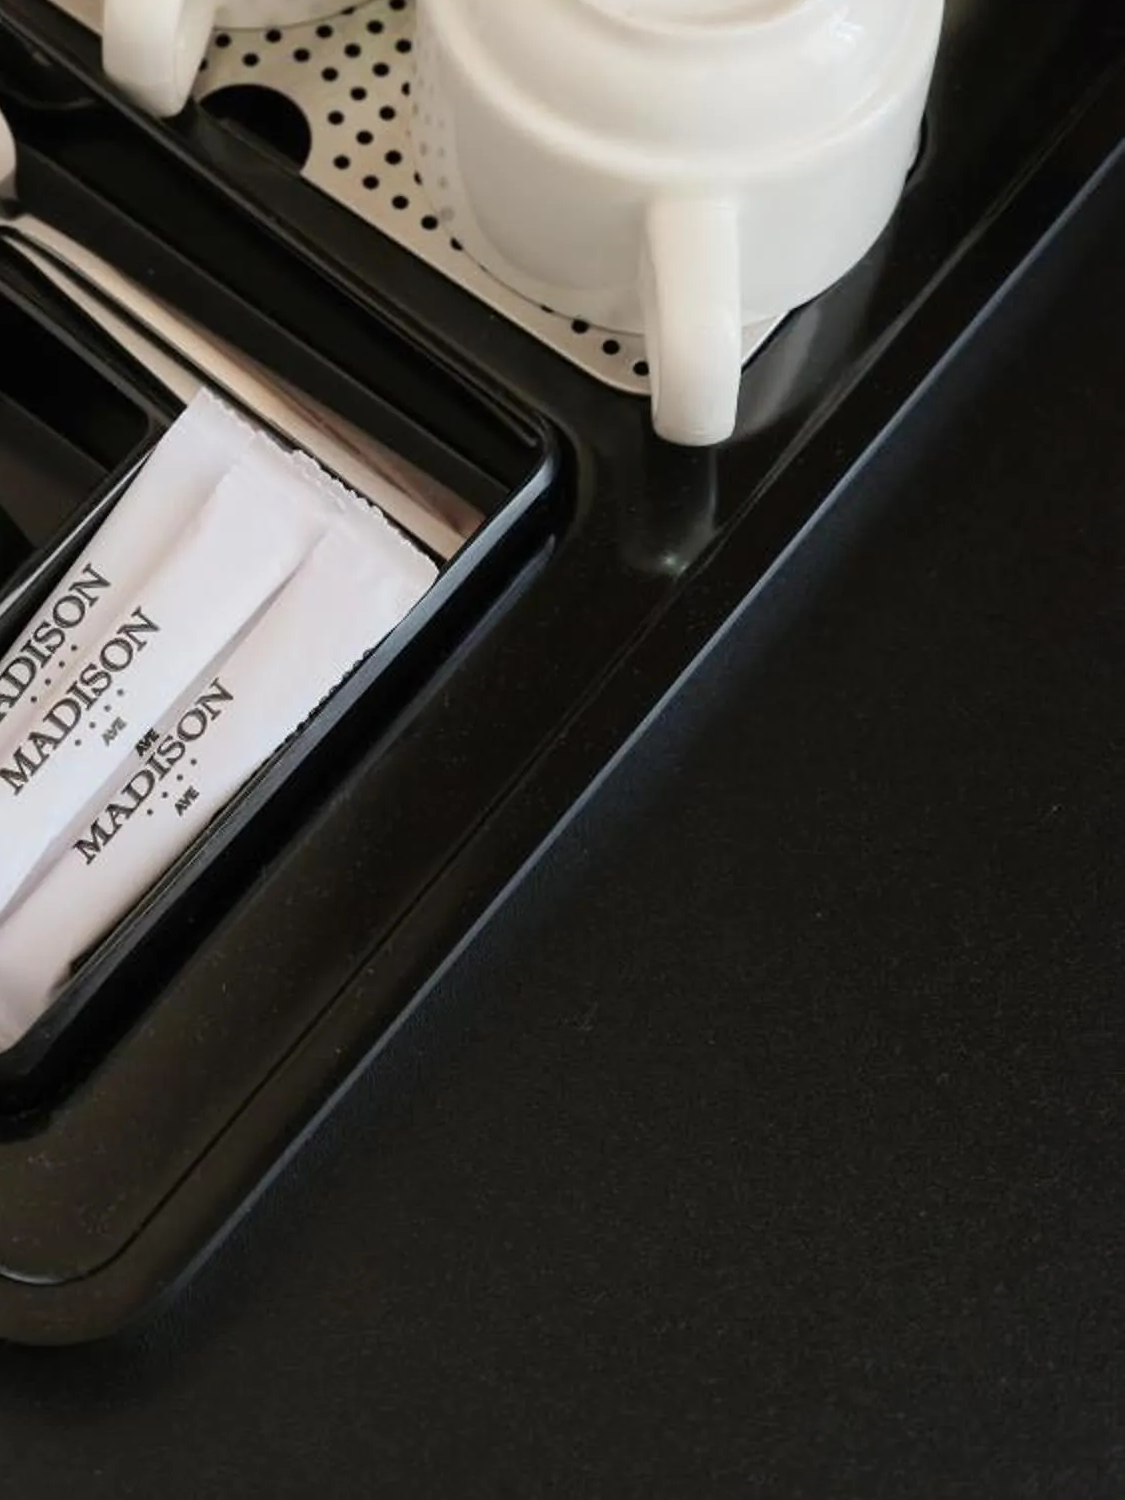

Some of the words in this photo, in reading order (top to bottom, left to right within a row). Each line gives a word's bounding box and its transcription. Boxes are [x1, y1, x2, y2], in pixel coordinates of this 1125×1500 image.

[101, 716, 128, 747] AVE
[134, 728, 161, 757] AVE
[73, 677, 234, 865] MADISON
[174, 785, 200, 817] AVE
